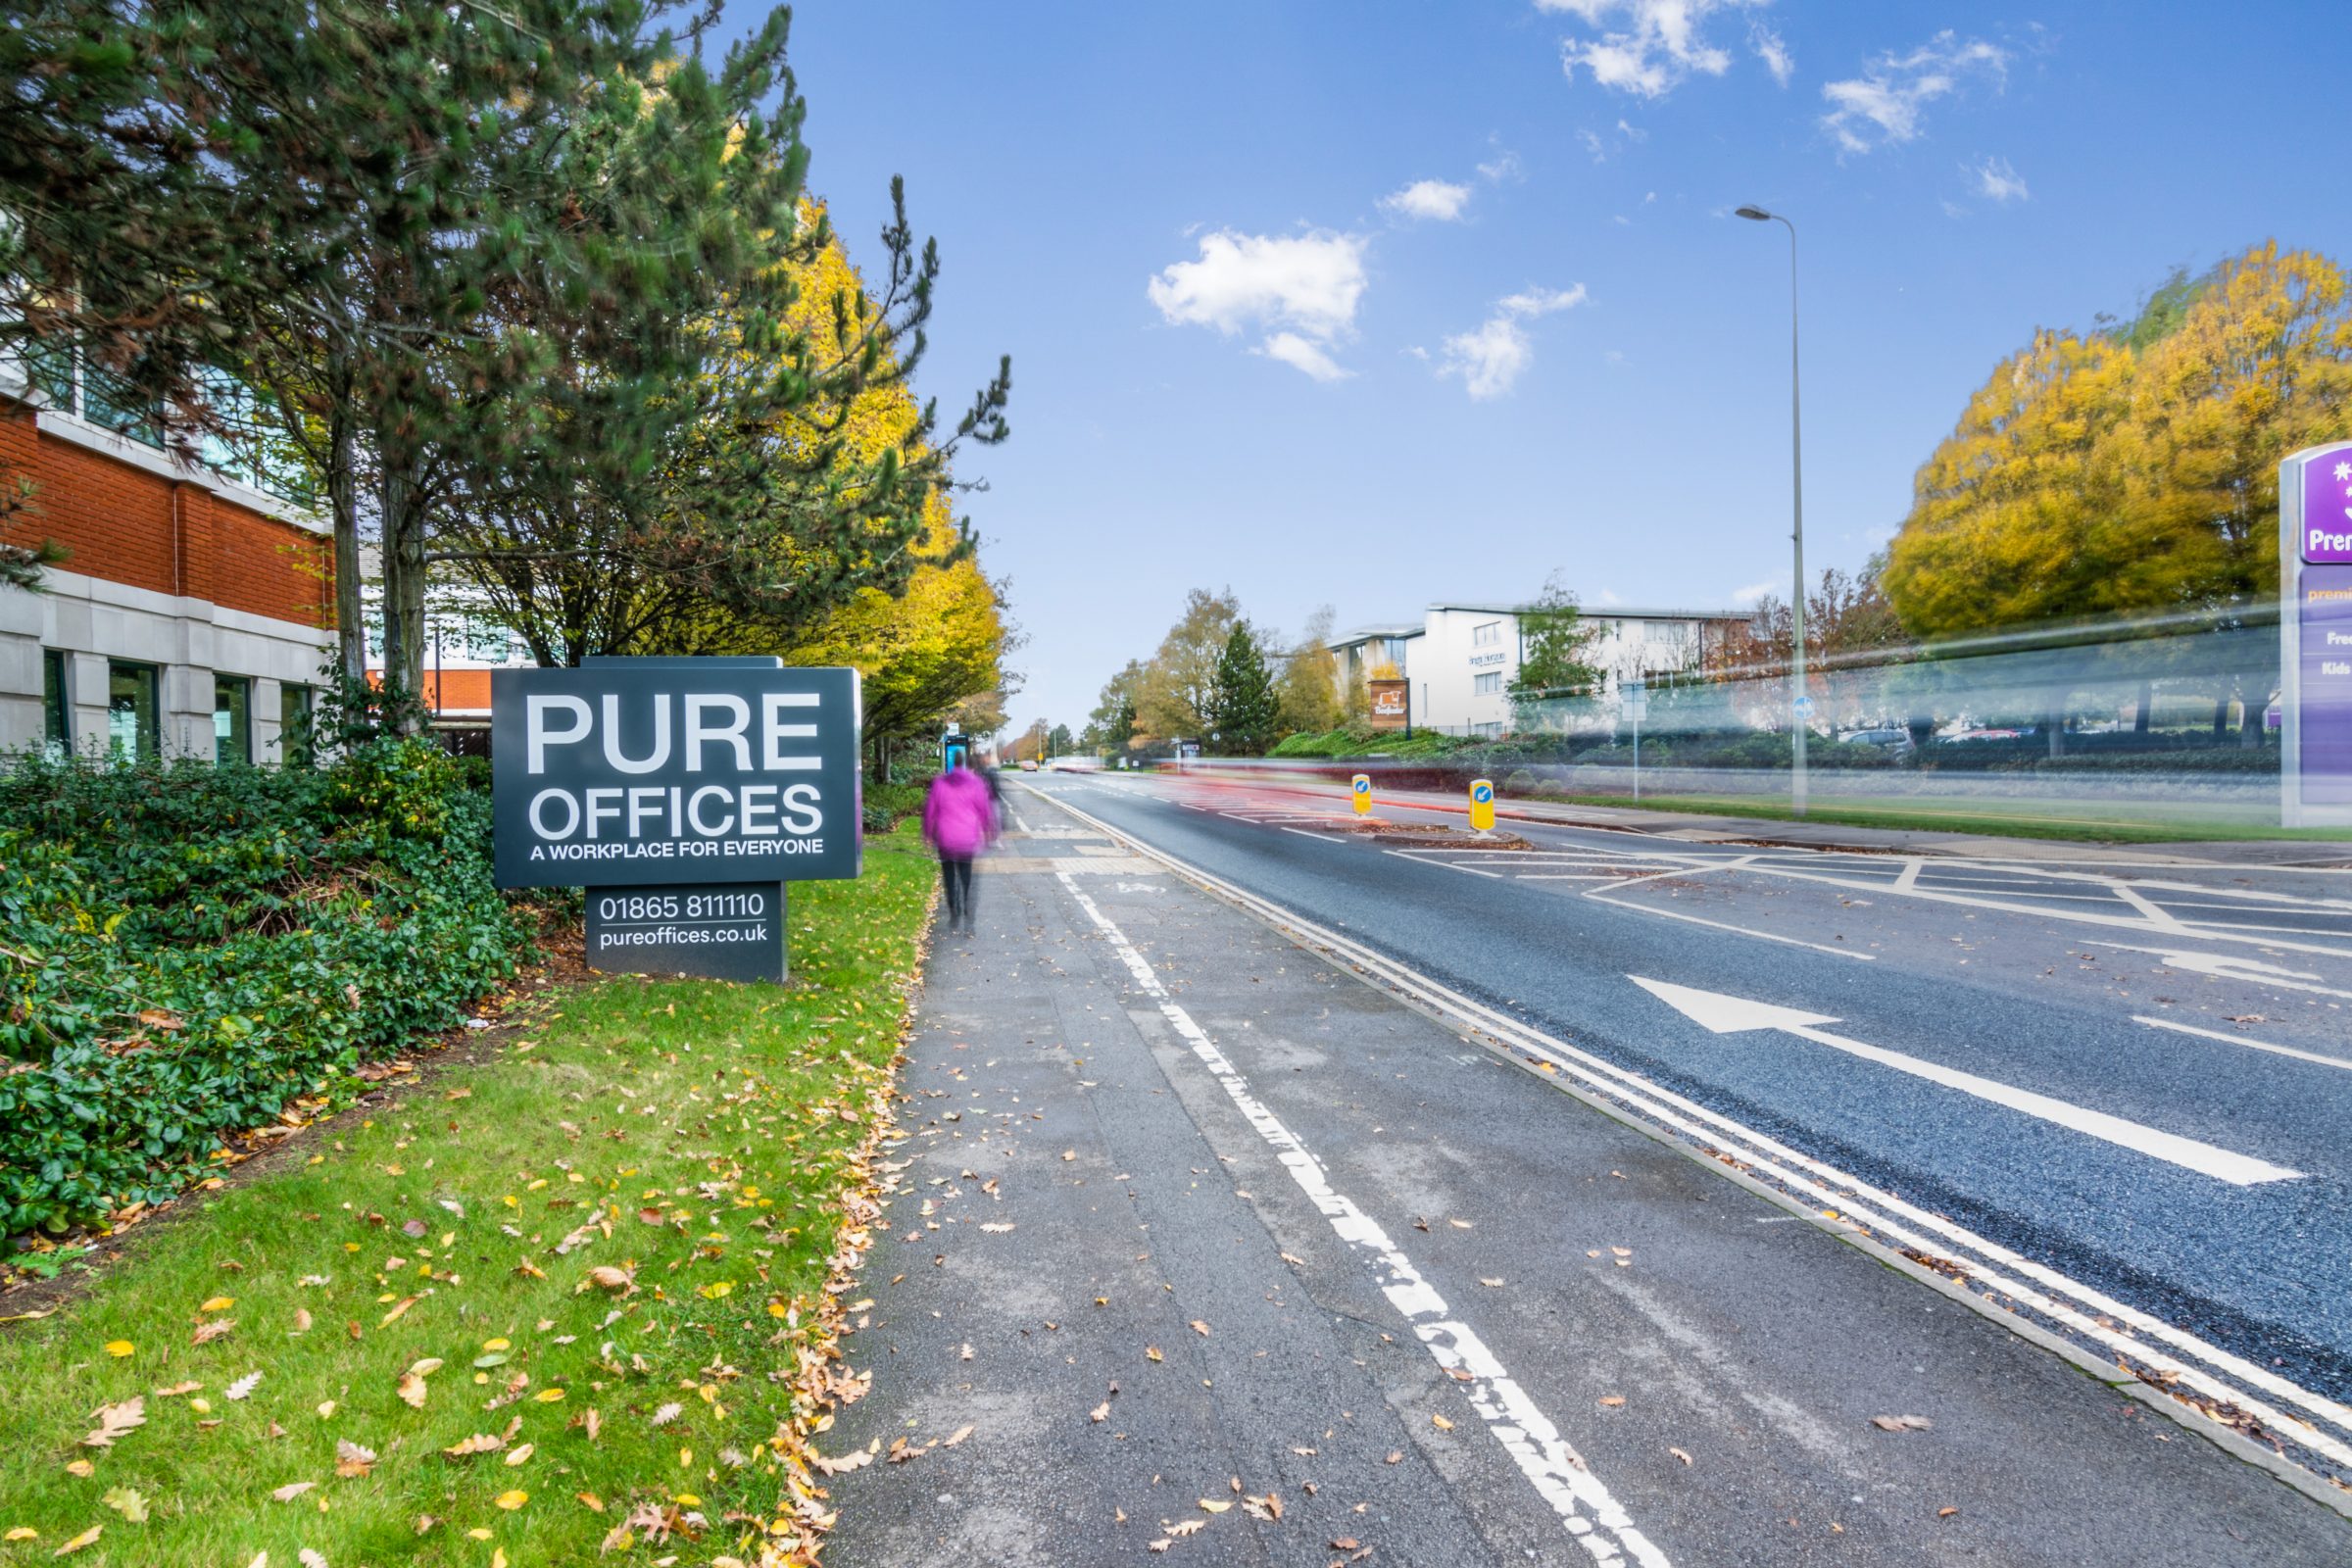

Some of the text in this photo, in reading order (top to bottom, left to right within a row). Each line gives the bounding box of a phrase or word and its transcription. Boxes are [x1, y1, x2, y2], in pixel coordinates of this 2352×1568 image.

[2322, 662, 2351, 675] Kids
[526, 692, 822, 774] PURE
[528, 784, 823, 840] OFFICES
[530, 839, 824, 860] A WORKPLACE FOR EVERYONE
[600, 893, 764, 920] 01865 811110
[600, 923, 767, 951] pureoffices.co.uk
